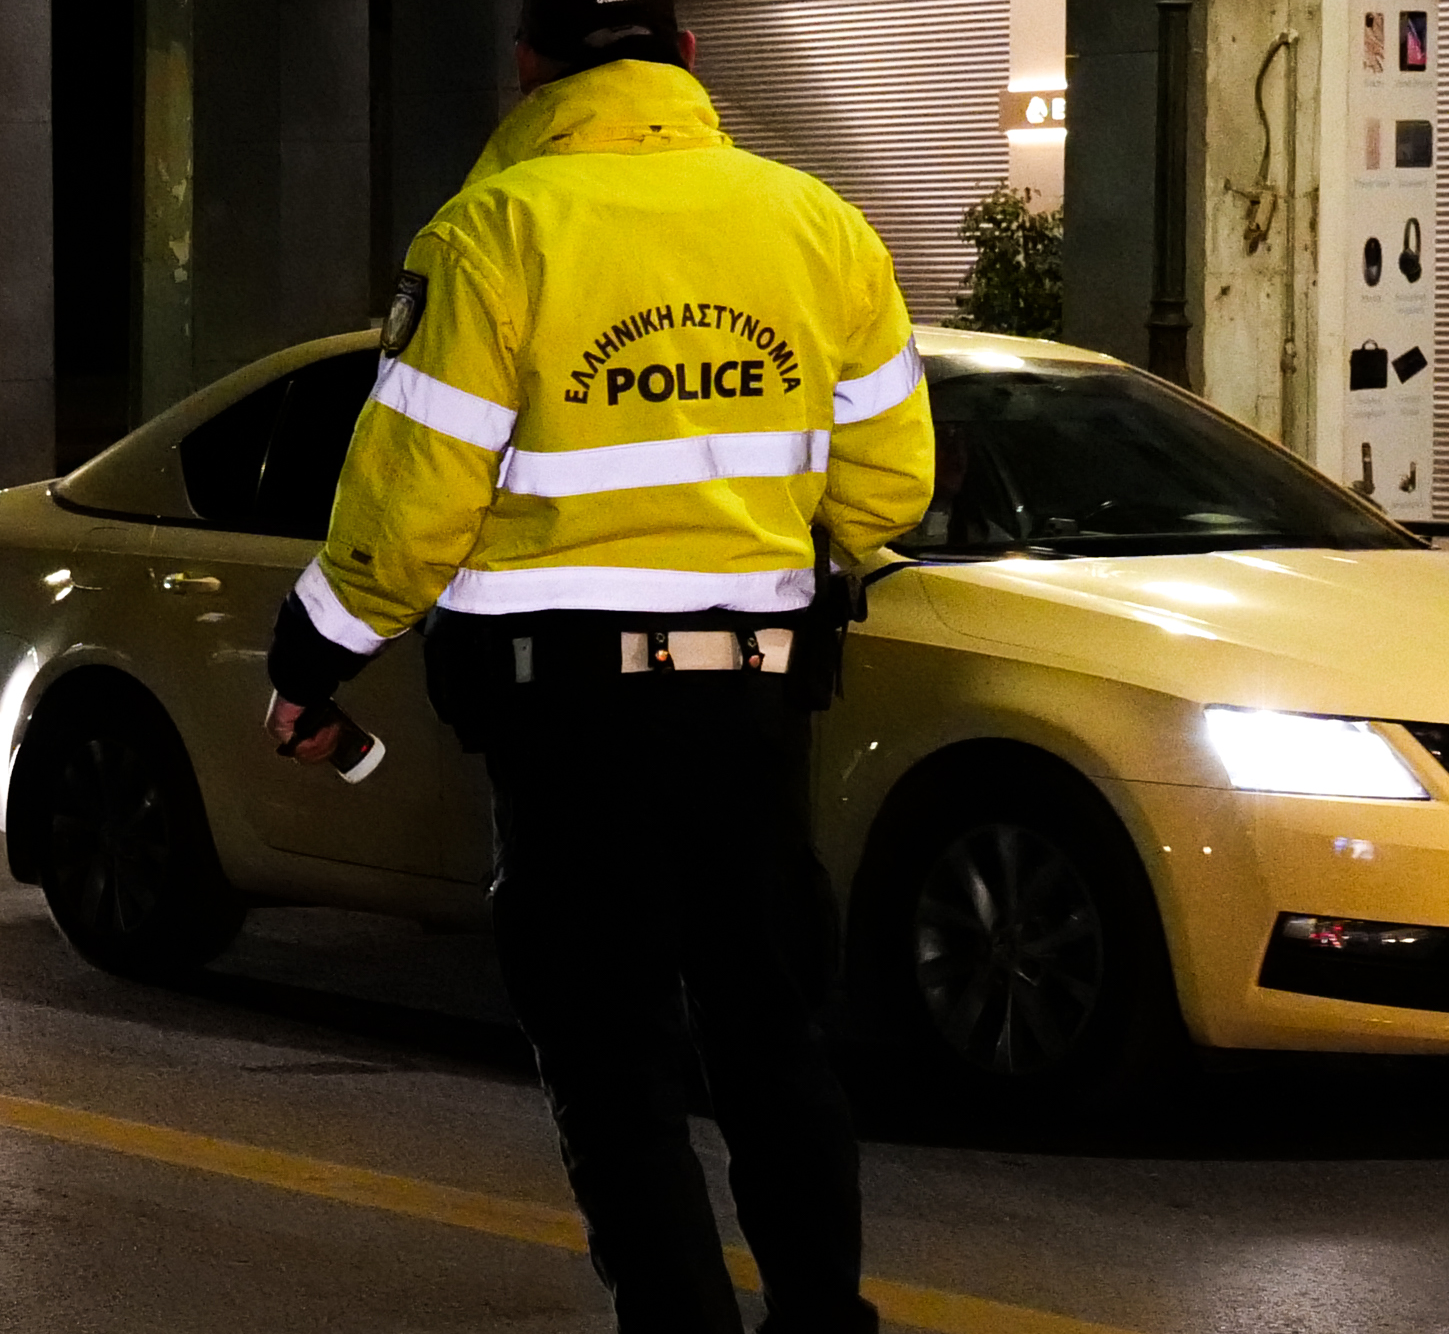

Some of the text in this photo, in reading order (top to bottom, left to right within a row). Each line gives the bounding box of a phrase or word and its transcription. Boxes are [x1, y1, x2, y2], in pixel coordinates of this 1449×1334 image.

[565, 303, 801, 405] ΕΛΛΗΝΙΚΗ ΑΣΤΥΝΟΜΙΑ
[606, 360, 765, 406] POLICE
